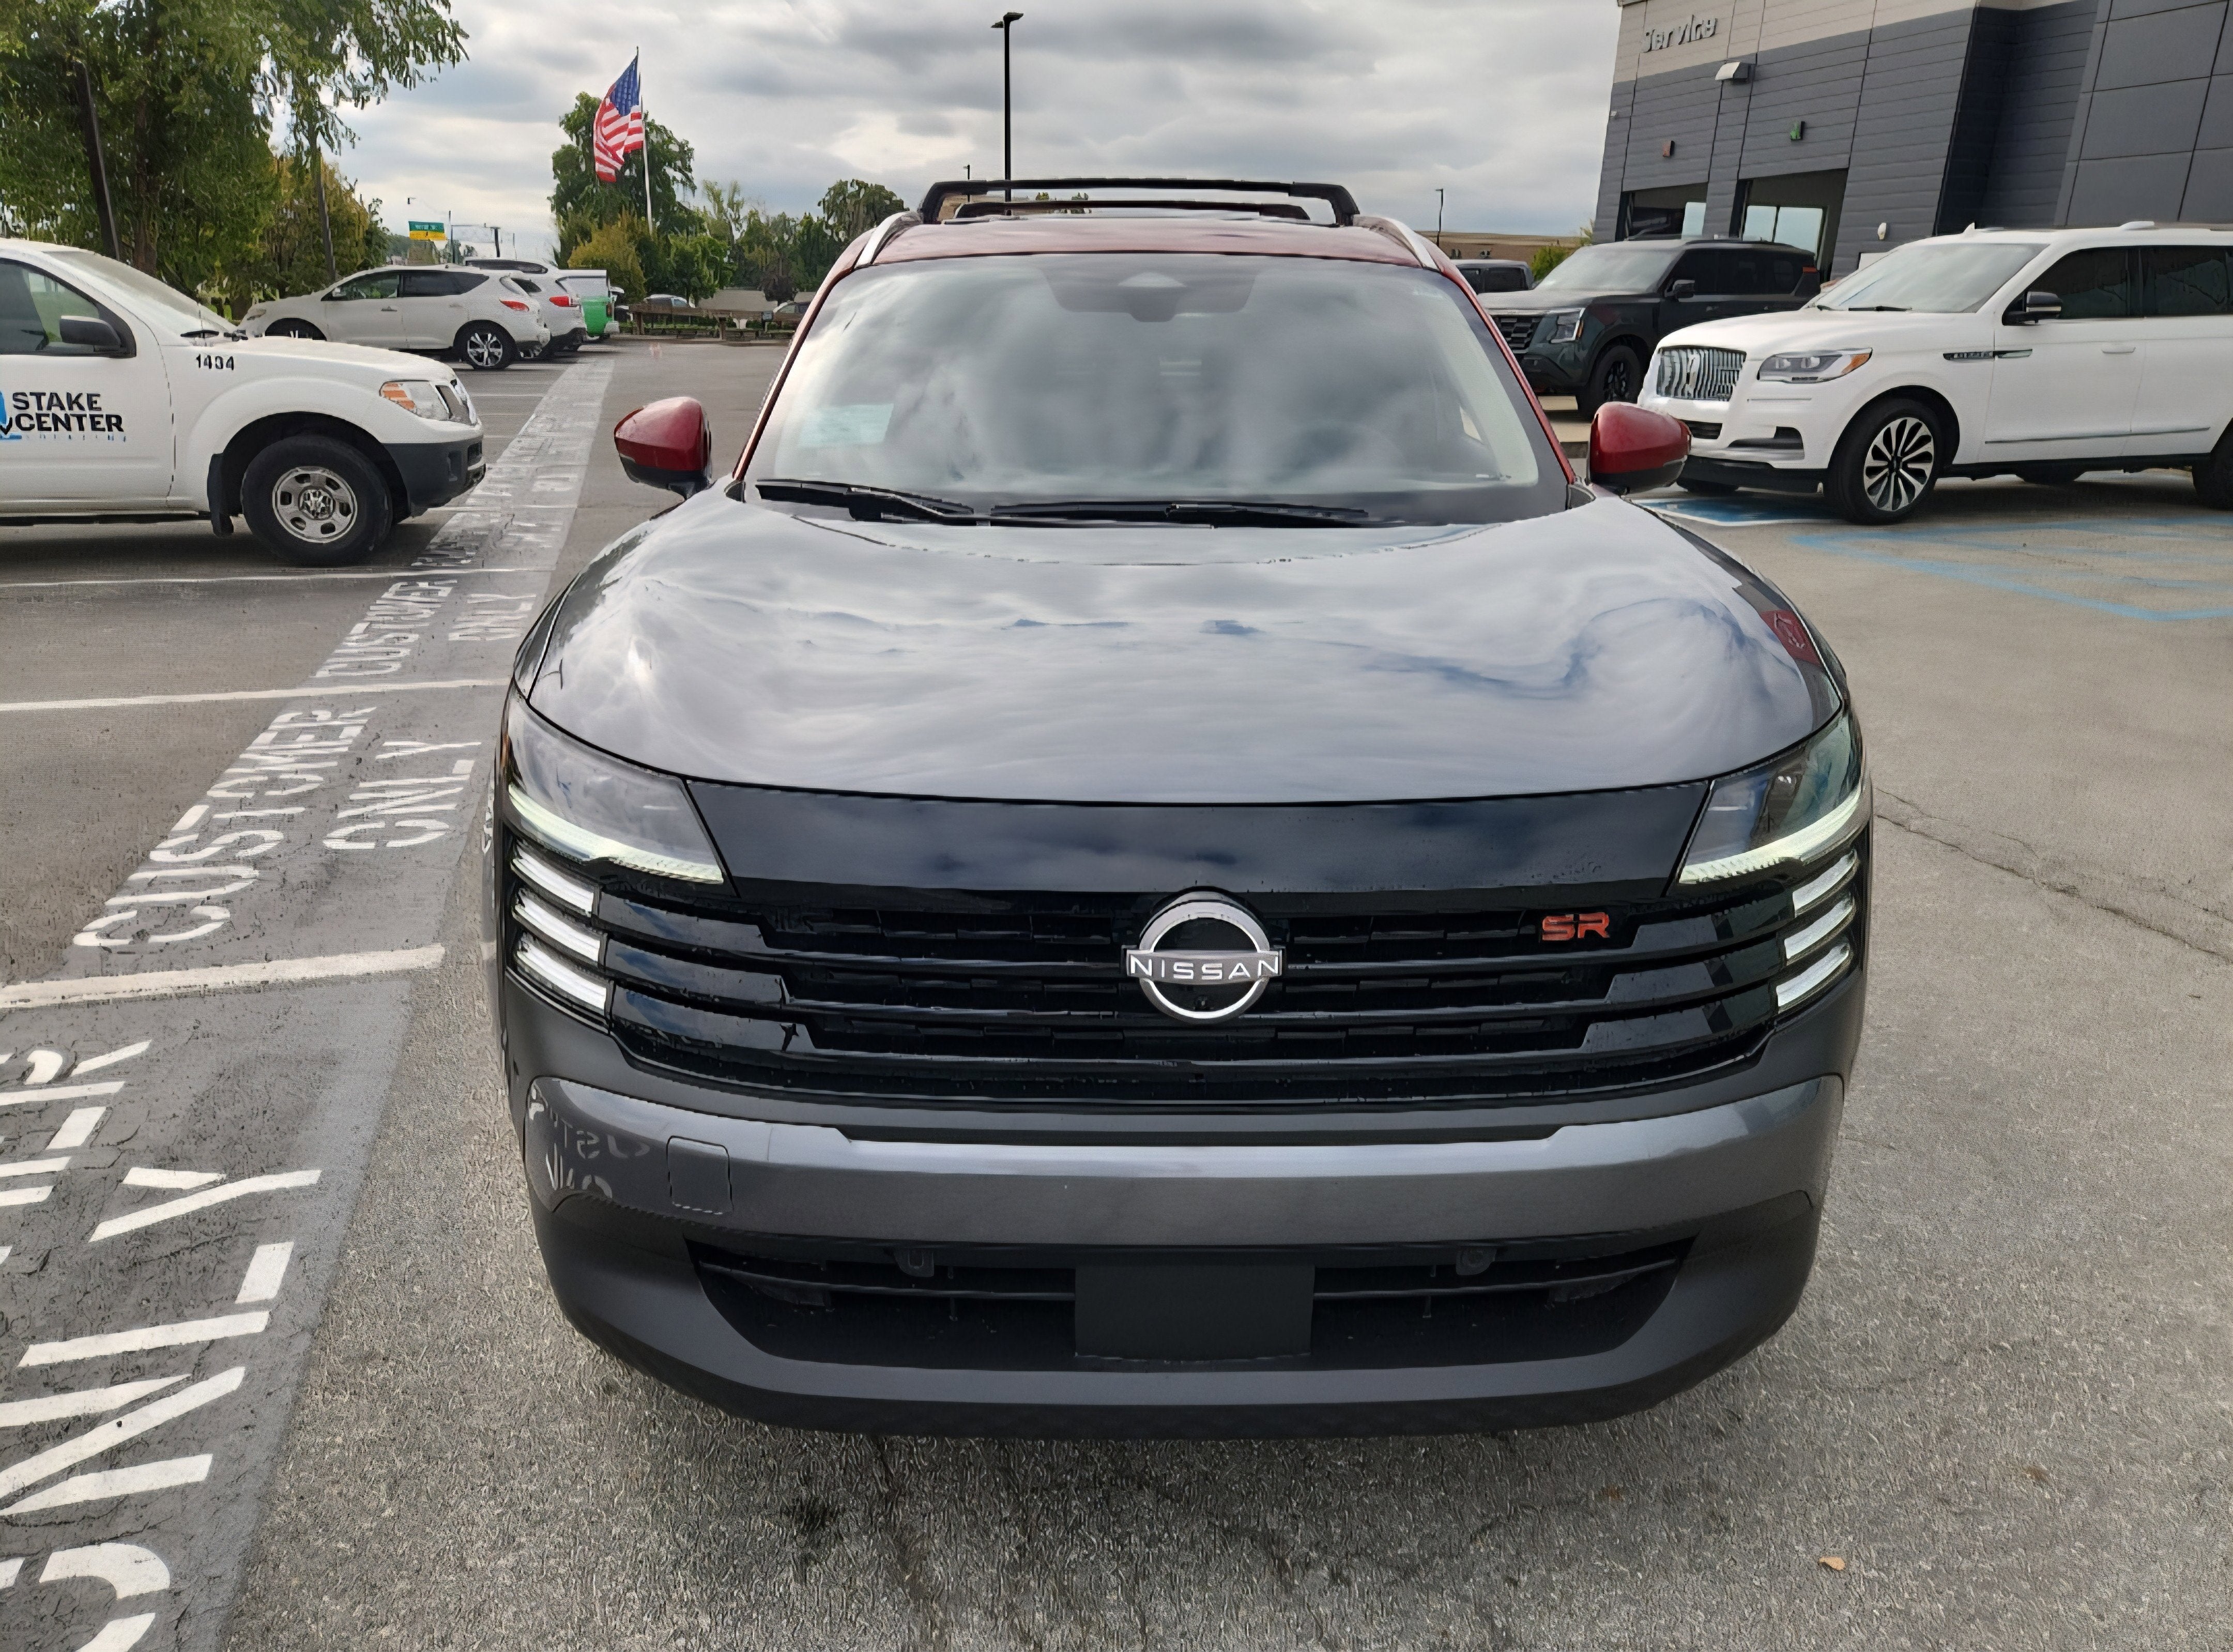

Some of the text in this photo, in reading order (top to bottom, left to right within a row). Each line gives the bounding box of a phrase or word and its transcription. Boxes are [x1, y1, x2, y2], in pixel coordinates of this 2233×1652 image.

[12, 391, 102, 411] STAKE
[15, 412, 124, 432] CENTER
[323, 741, 482, 850] ONLY
[73, 706, 377, 947] CUSTOMER
[1542, 912, 1610, 941] SR
[1130, 955, 1279, 980] NISSAN
